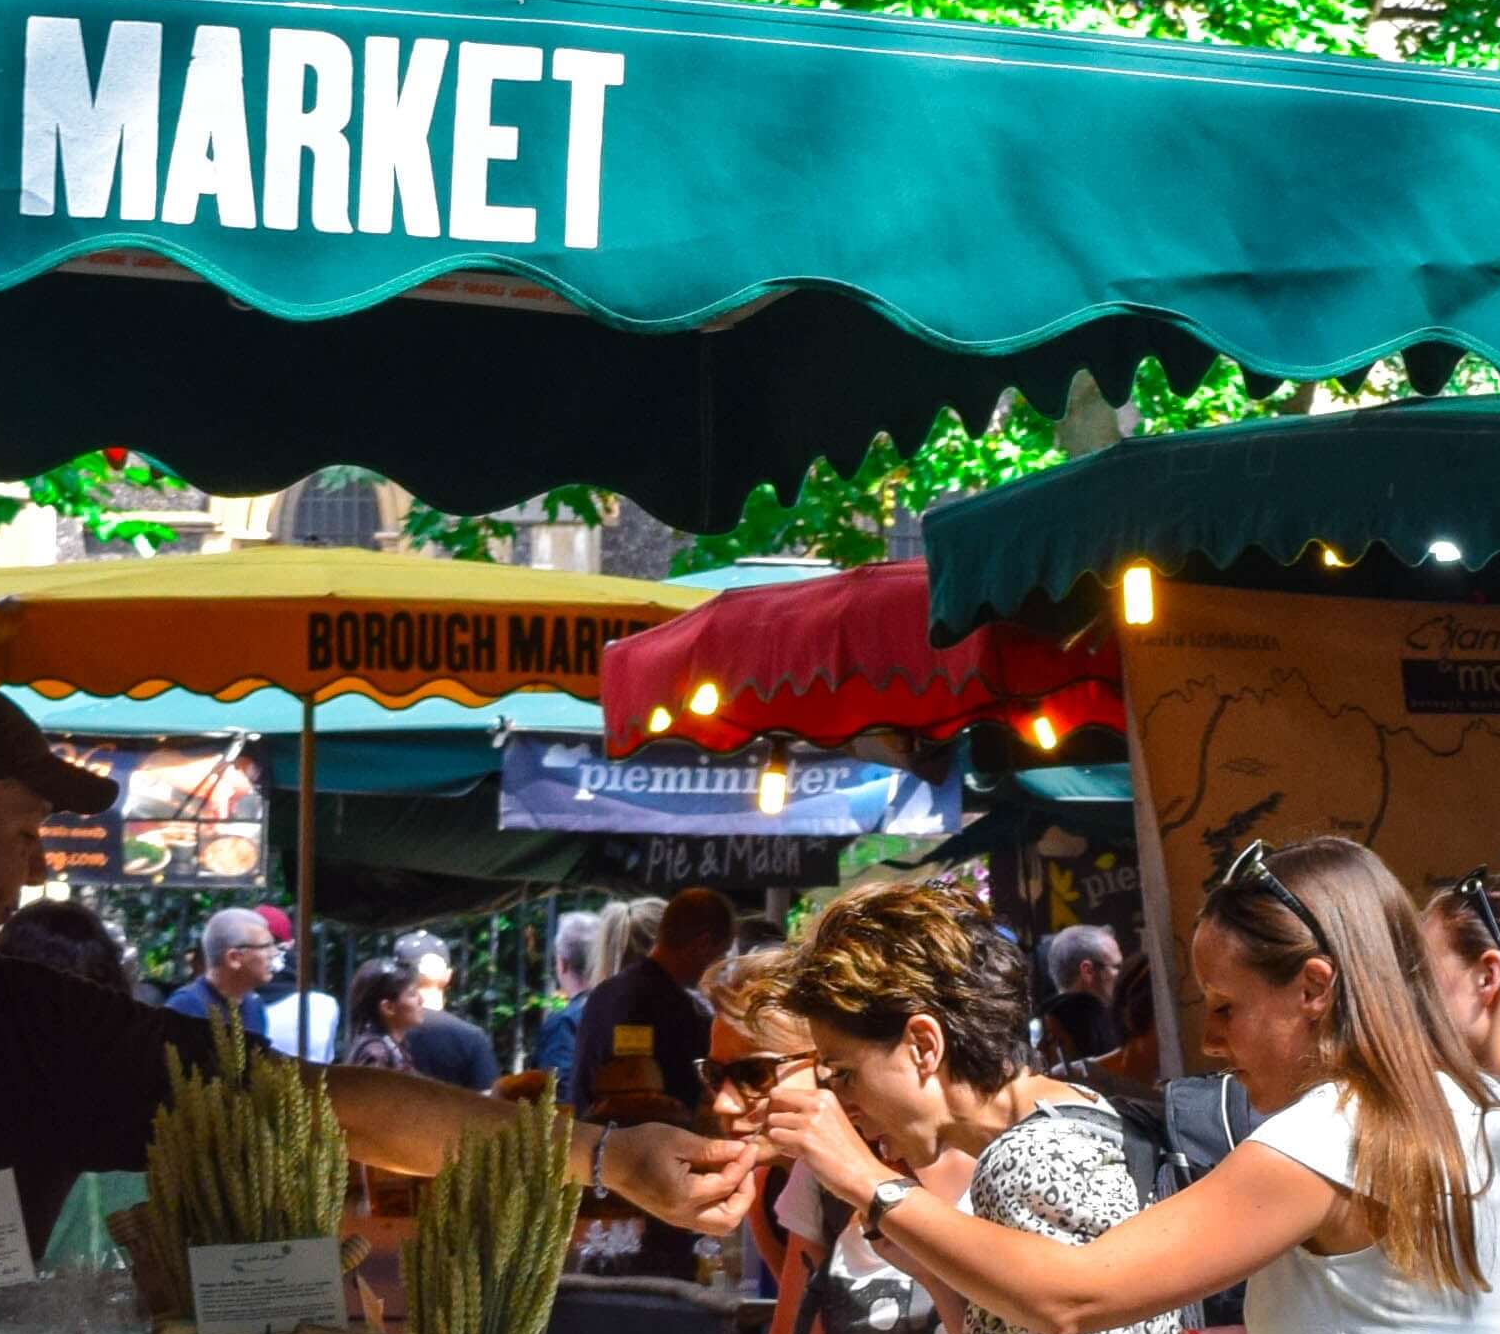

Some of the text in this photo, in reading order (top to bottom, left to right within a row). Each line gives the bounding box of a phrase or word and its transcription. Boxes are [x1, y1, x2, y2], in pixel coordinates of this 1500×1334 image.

[19, 14, 626, 250] MARKET
[307, 611, 666, 676] BOROUGH MAR
[576, 756, 851, 801] pieminiter
